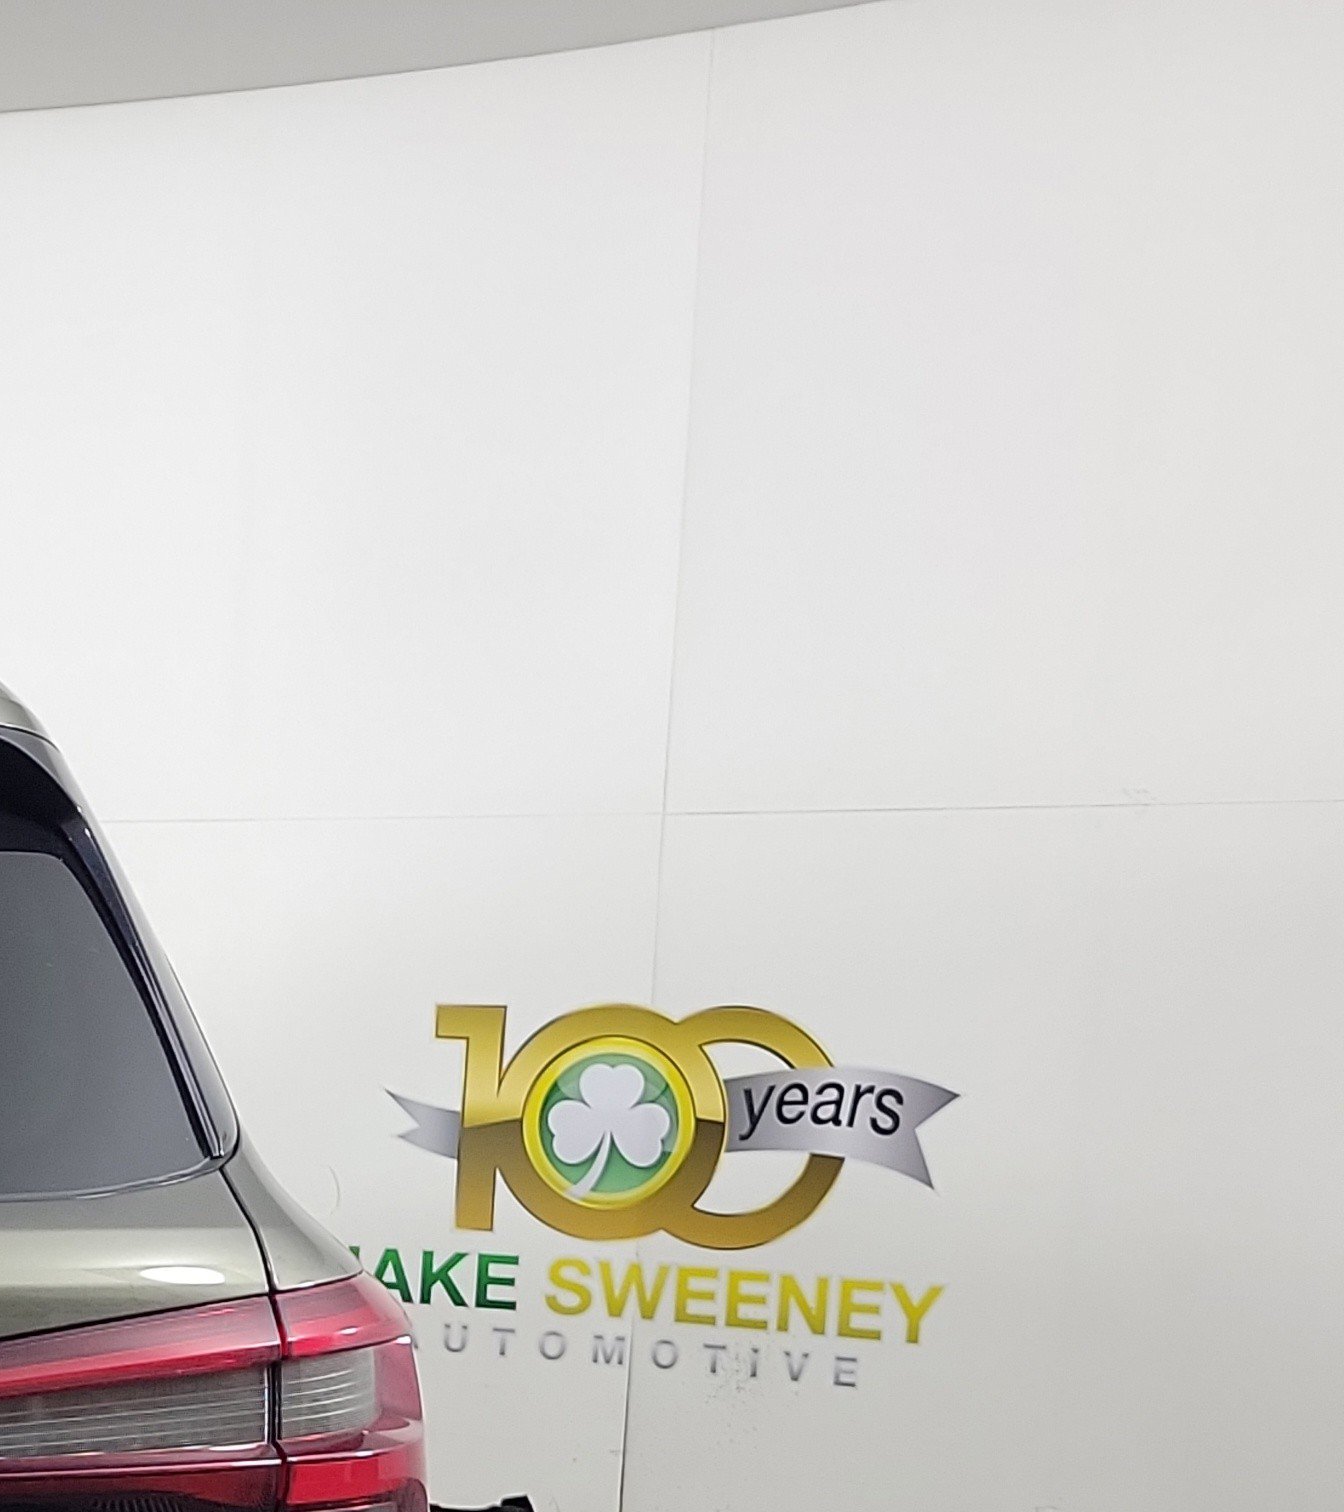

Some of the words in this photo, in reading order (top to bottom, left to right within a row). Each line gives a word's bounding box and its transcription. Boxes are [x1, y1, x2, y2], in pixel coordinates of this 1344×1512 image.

[739, 1080, 904, 1141] years
[348, 1245, 519, 1310] AKE
[544, 1256, 945, 1344] SWEENEY
[413, 1323, 859, 1388] UTOMOTIVE
